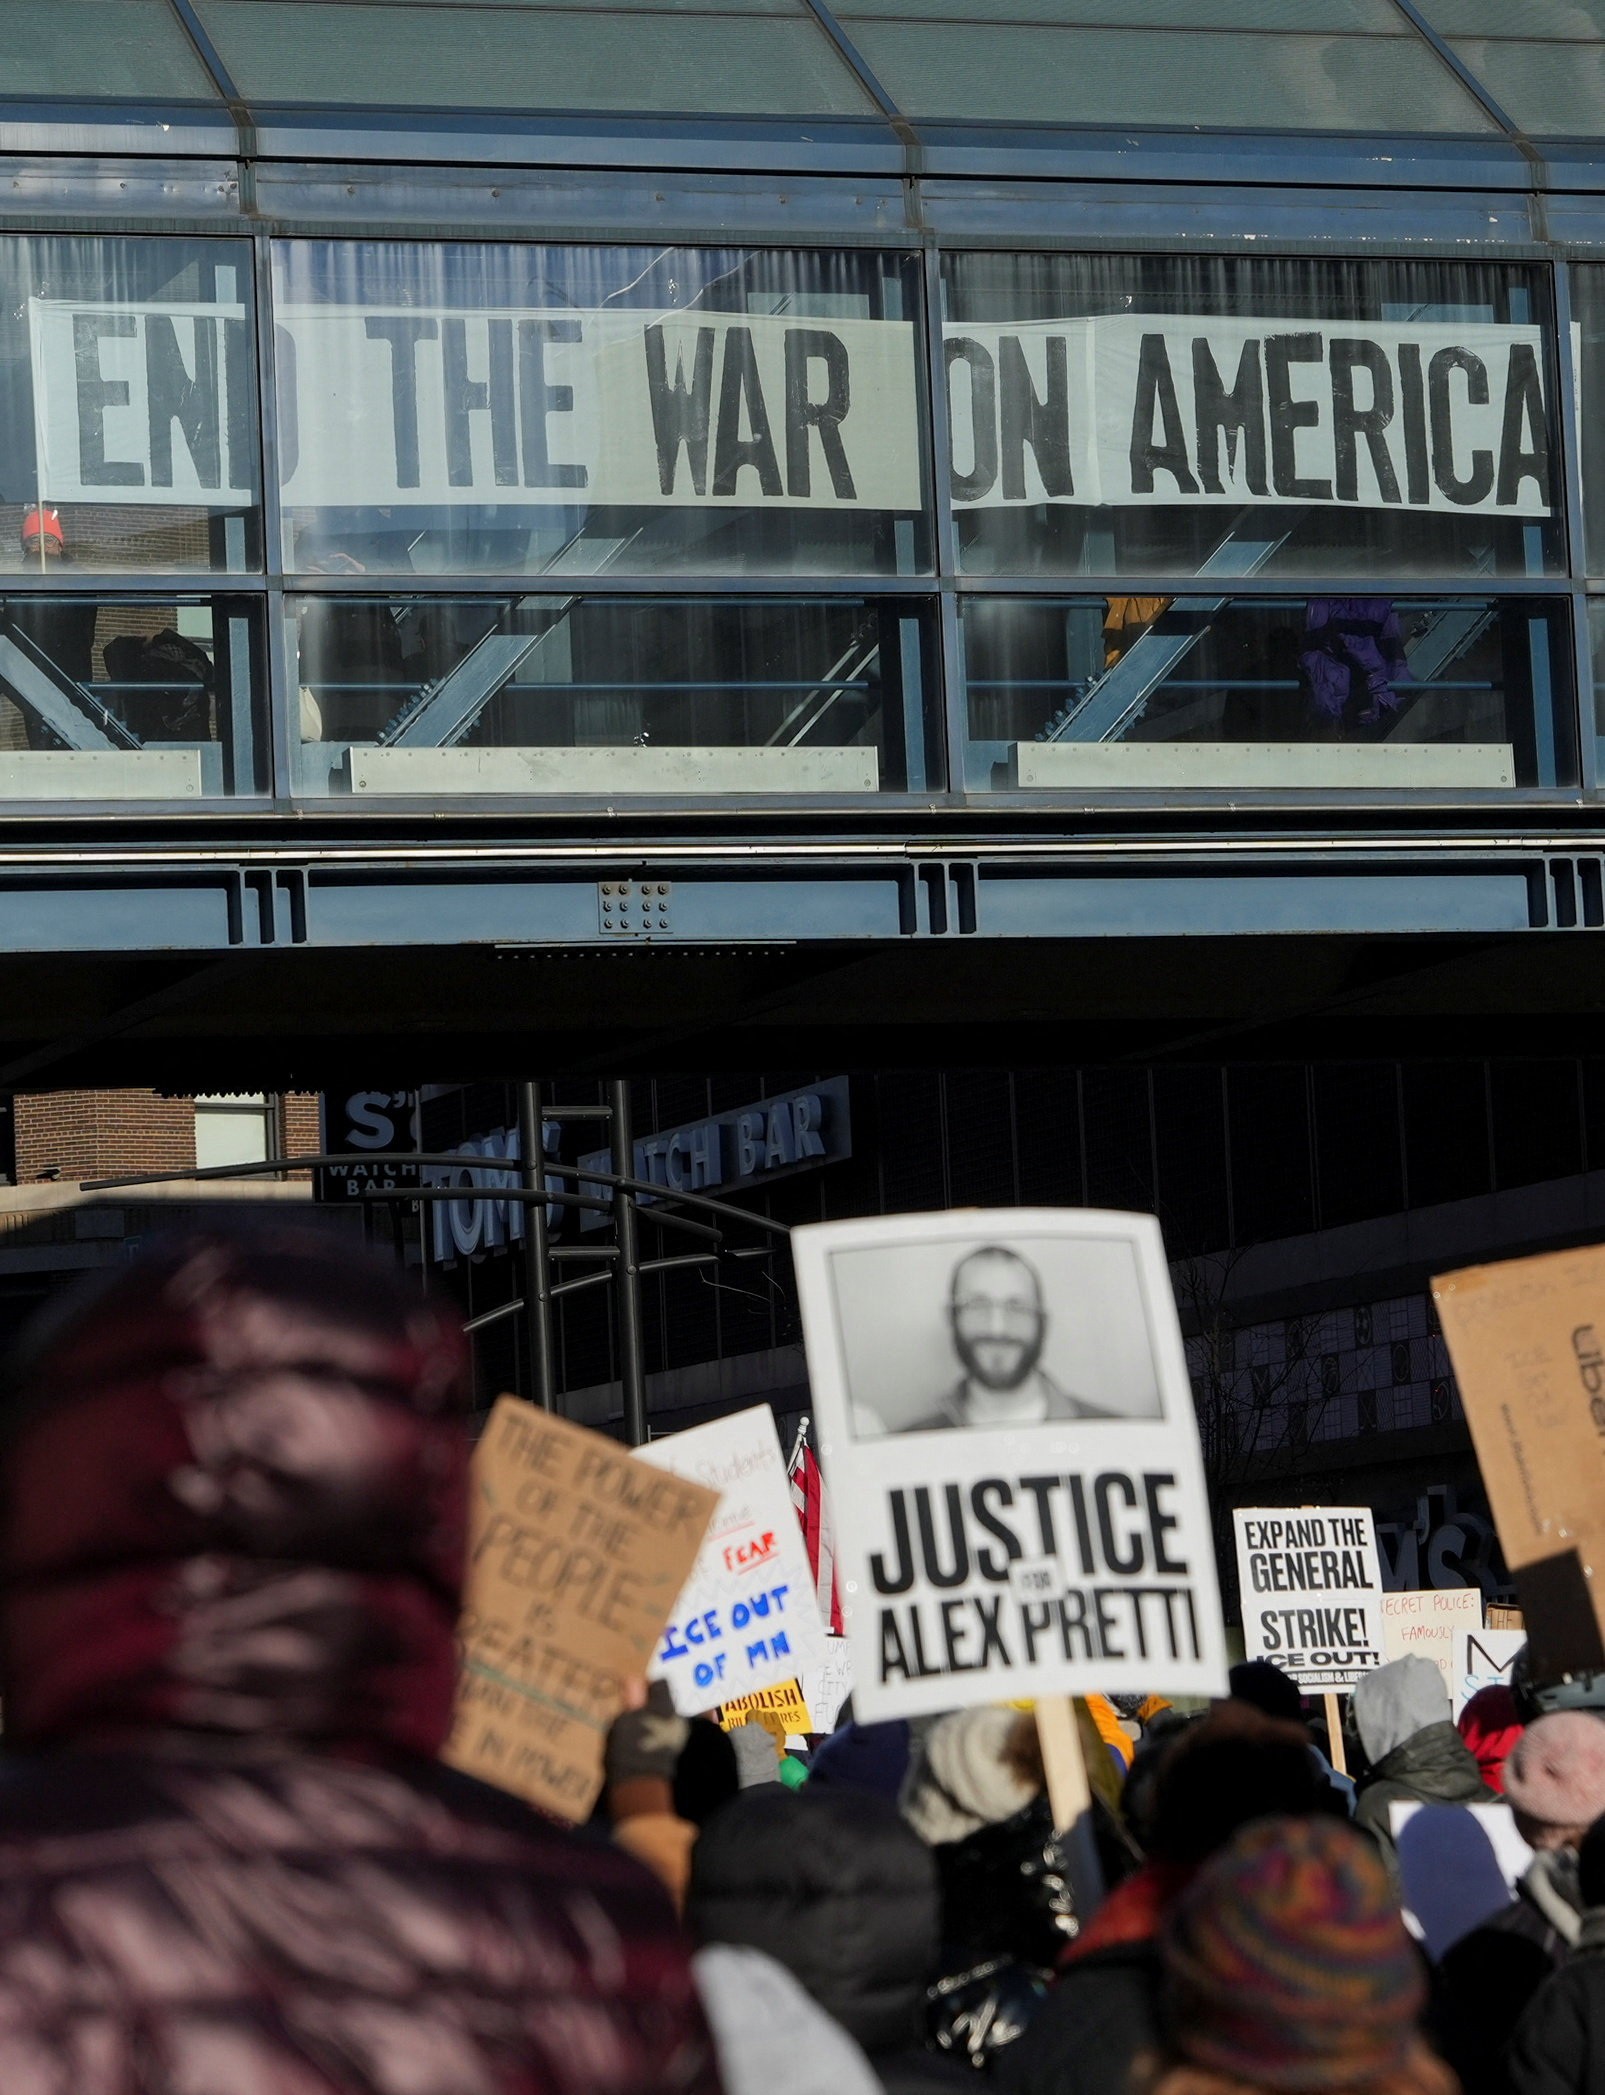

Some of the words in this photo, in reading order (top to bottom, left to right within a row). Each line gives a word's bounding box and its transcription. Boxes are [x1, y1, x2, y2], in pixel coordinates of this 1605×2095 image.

[73, 313, 299, 489] END
[364, 317, 588, 489] THE
[644, 324, 857, 499] WAR
[943, 336, 1074, 500] ON
[1131, 331, 1552, 507] AMERICA
[736, 1094, 828, 1176] BAR
[870, 1472, 1189, 1595] JUSTICE
[1244, 1519, 1326, 1549] EXPAND
[1327, 1518, 1368, 1547] THE
[1250, 1550, 1374, 1593] GENERAL
[660, 1609, 723, 1662] ICE
[731, 1585, 789, 1630] OUT
[1433, 1593, 1475, 1612] POLICE:
[880, 1596, 1013, 1685] ALEX
[1018, 1587, 1203, 1664] PRETTI
[1260, 1608, 1369, 1650] STRIKE!
[693, 1652, 727, 1688] OF
[746, 1630, 791, 1669] MN
[1310, 1651, 1380, 1667] OUT!
[724, 1688, 799, 1713] ABOLISH
